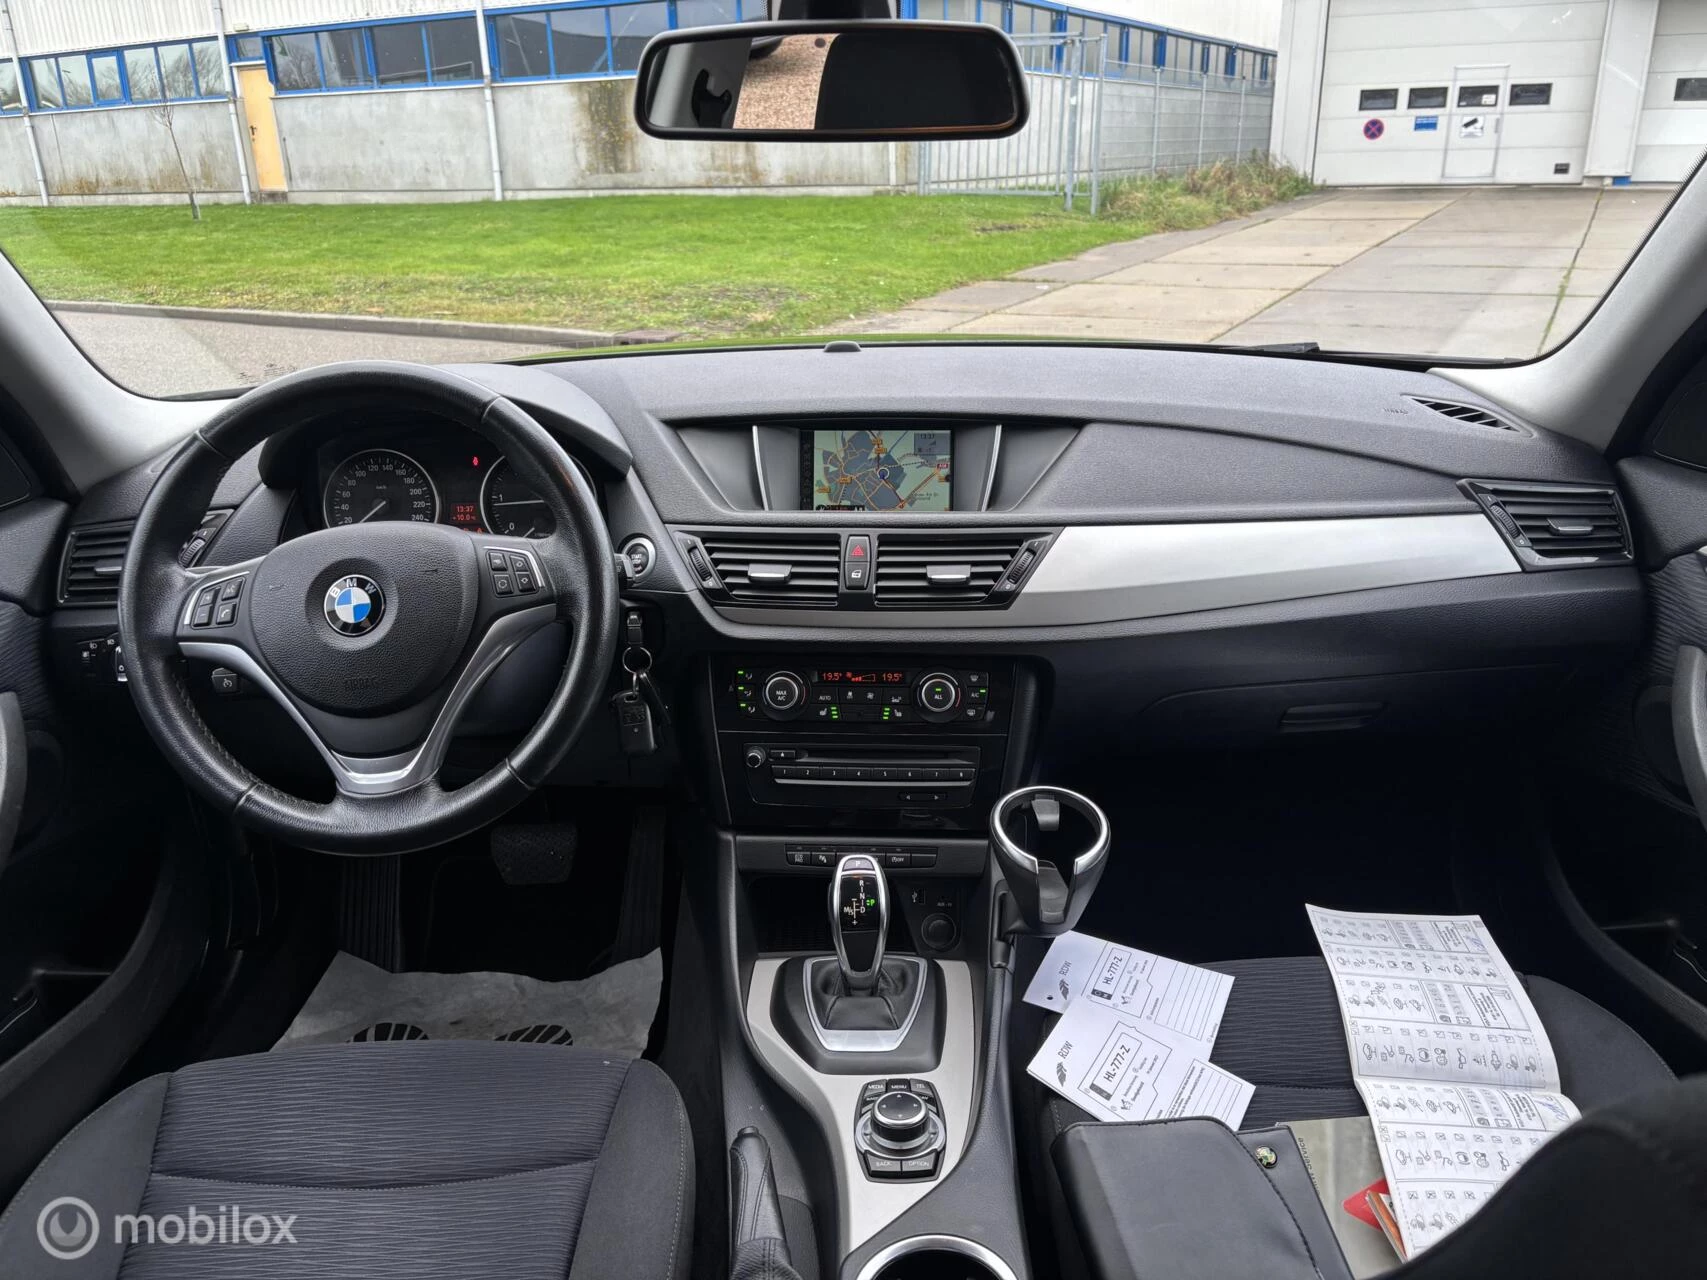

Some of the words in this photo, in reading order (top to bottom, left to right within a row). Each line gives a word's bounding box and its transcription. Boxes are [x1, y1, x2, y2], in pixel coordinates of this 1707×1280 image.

[382, 463, 394, 471] 140
[404, 477, 415, 485] 180
[409, 488, 422, 496] 200
[508, 522, 515, 530] 0
[329, 578, 377, 598] BMW
[1059, 961, 1072, 976] RDW
[1102, 956, 1123, 985] HL-777-Z
[1057, 1040, 1073, 1059] RDW
[1103, 1044, 1131, 1082] HL-777-Z
